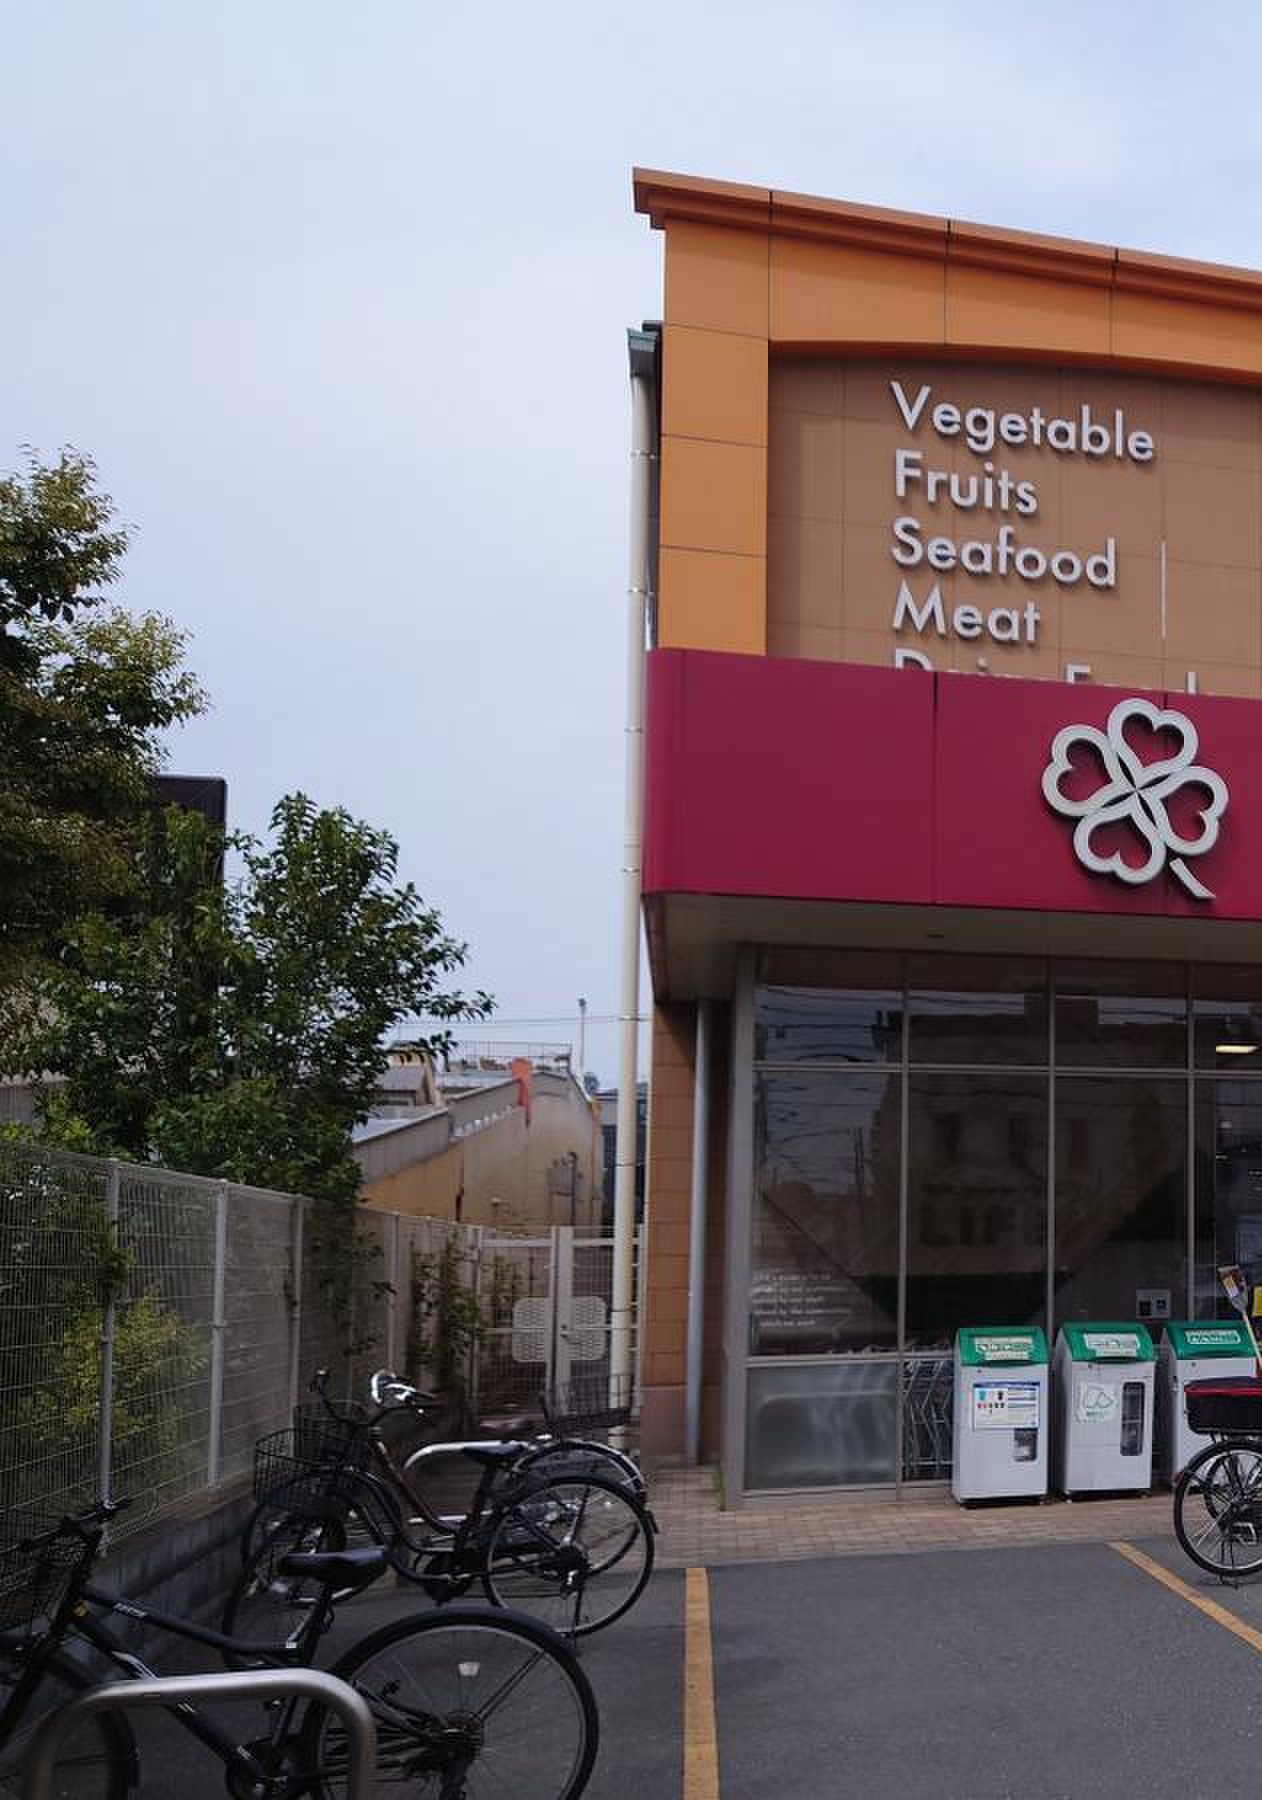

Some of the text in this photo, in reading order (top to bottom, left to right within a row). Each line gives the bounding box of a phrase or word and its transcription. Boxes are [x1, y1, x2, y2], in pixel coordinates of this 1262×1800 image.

[890, 380, 1155, 462] Vegetable
[894, 449, 1039, 514] Fruits
[891, 516, 1117, 588] Seafood
[892, 580, 1041, 643] Meat
